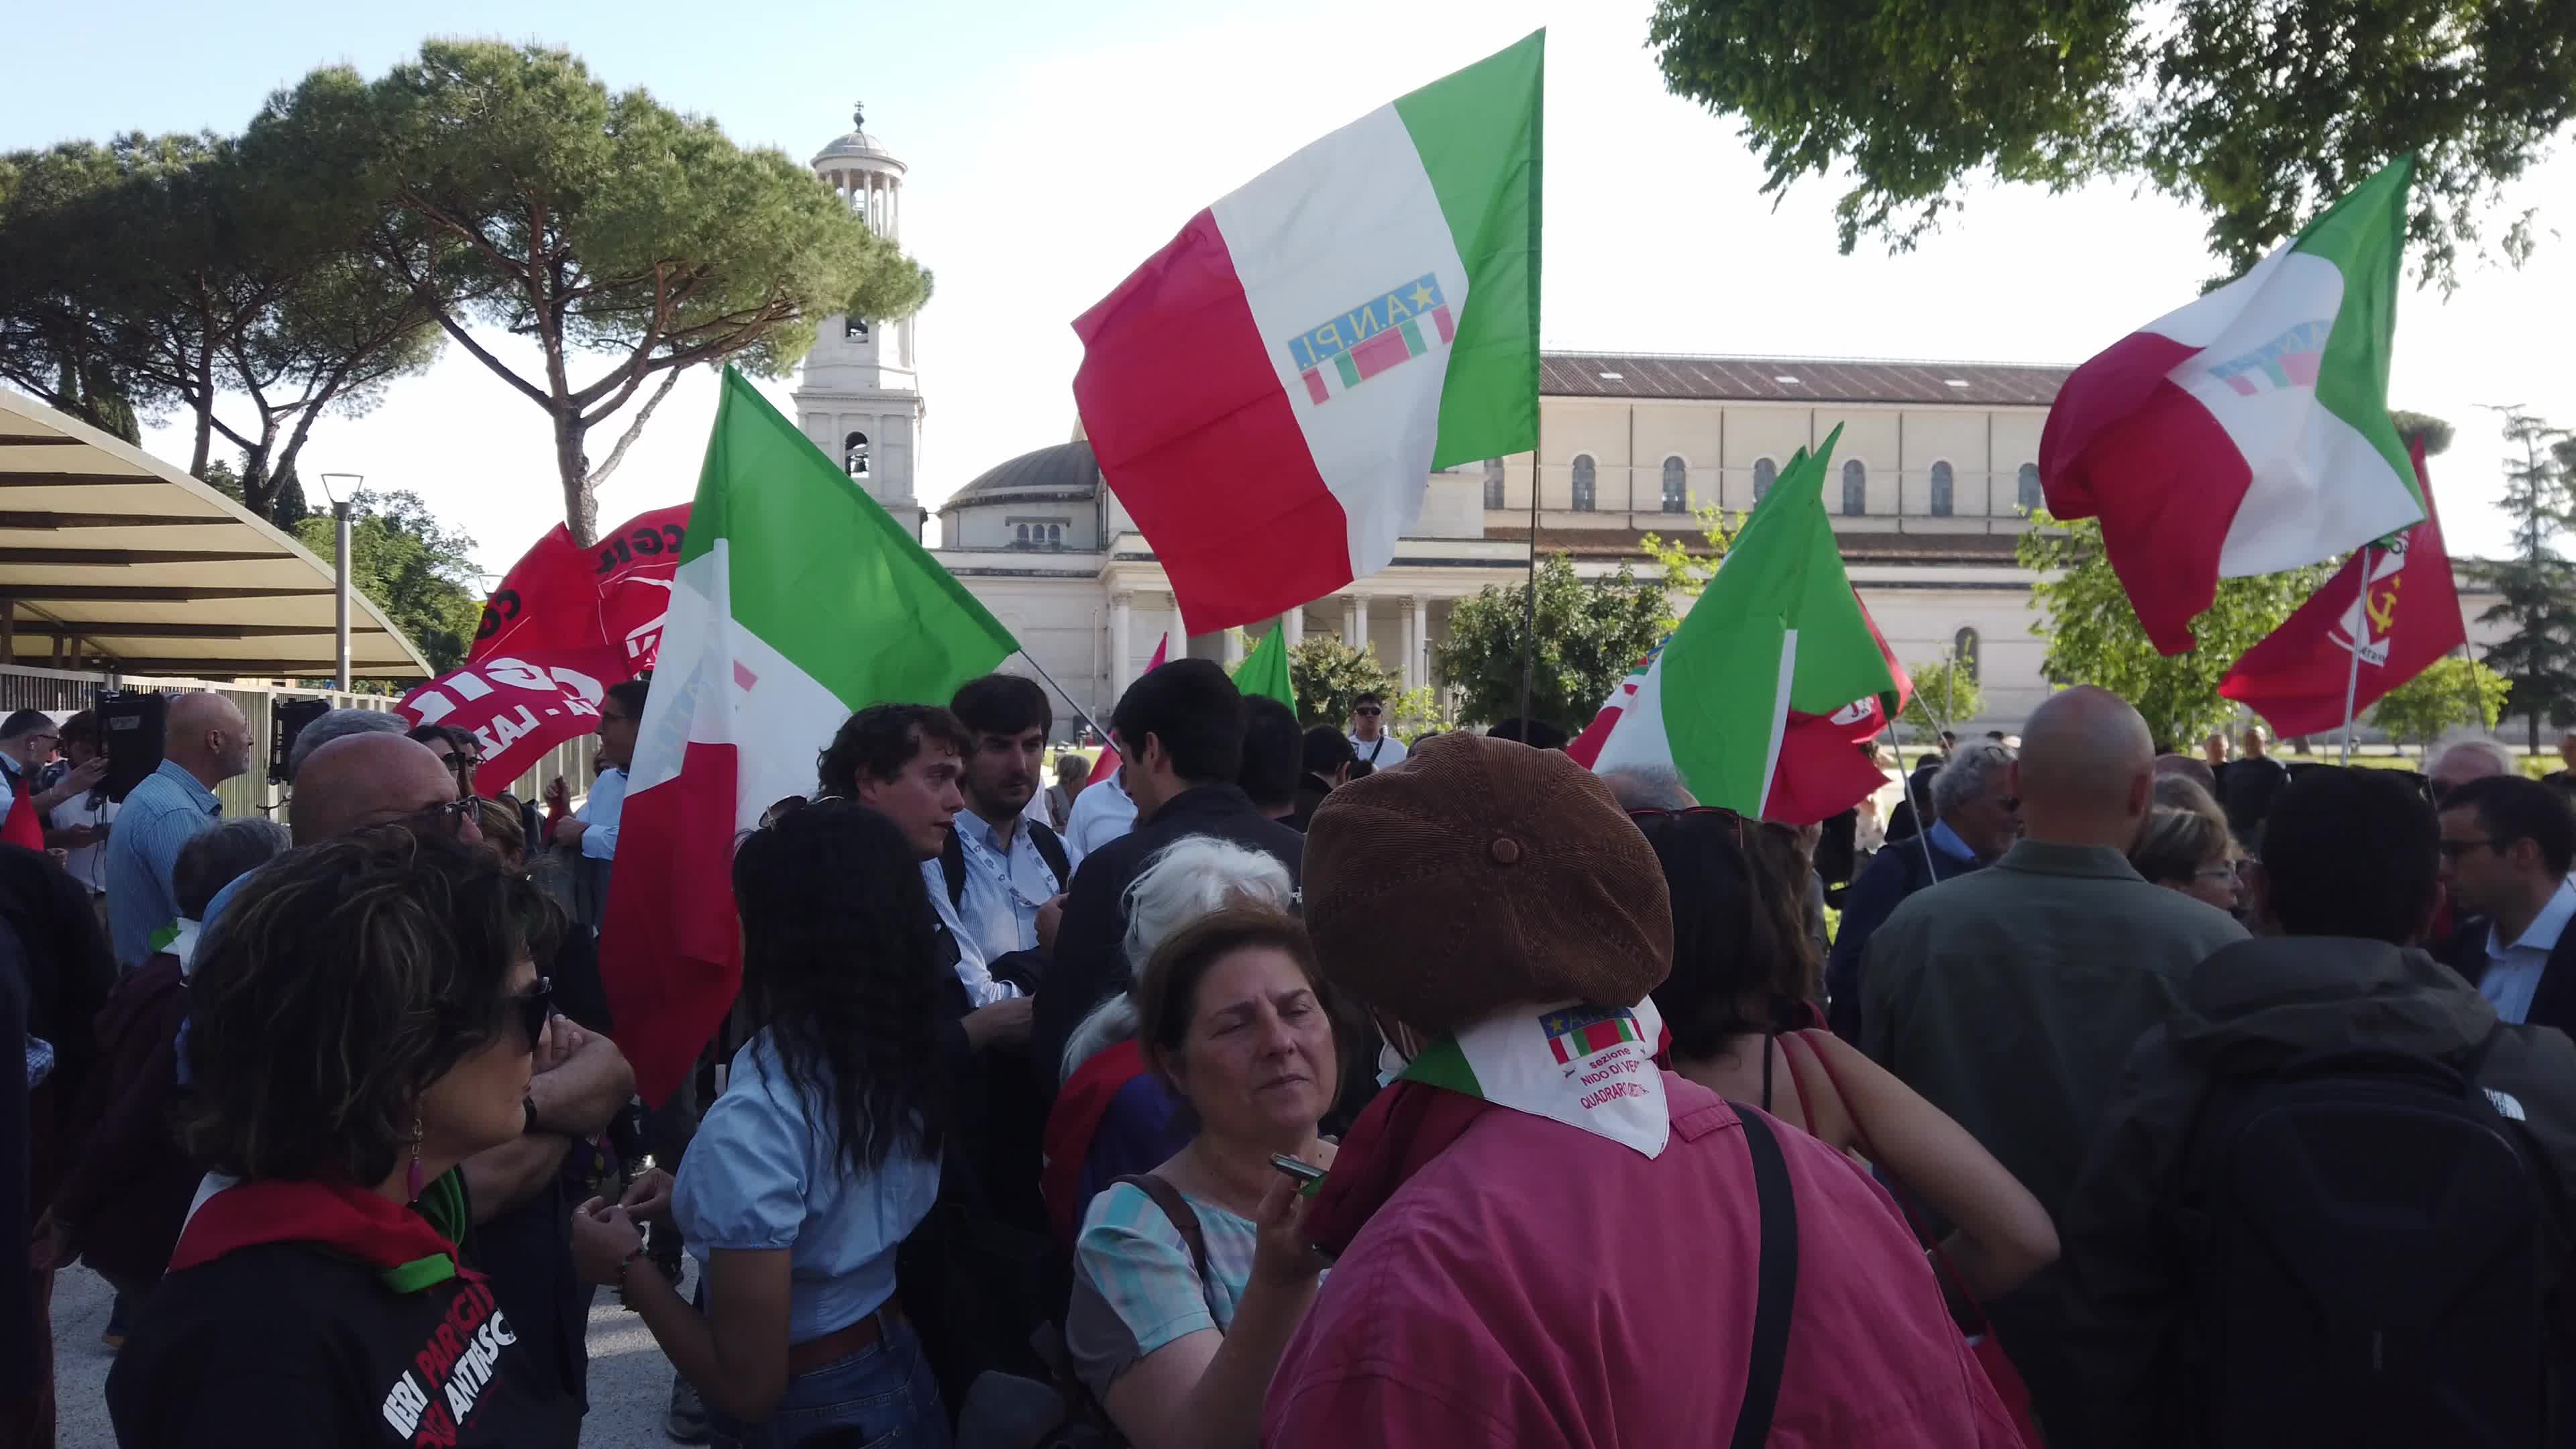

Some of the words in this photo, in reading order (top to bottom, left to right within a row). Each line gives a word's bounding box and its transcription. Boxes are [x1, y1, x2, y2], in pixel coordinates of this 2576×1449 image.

[1589, 1046, 1631, 1069] sezione
[1580, 1070, 1610, 1087] NIDO
[1609, 1063, 1623, 1075] DI
